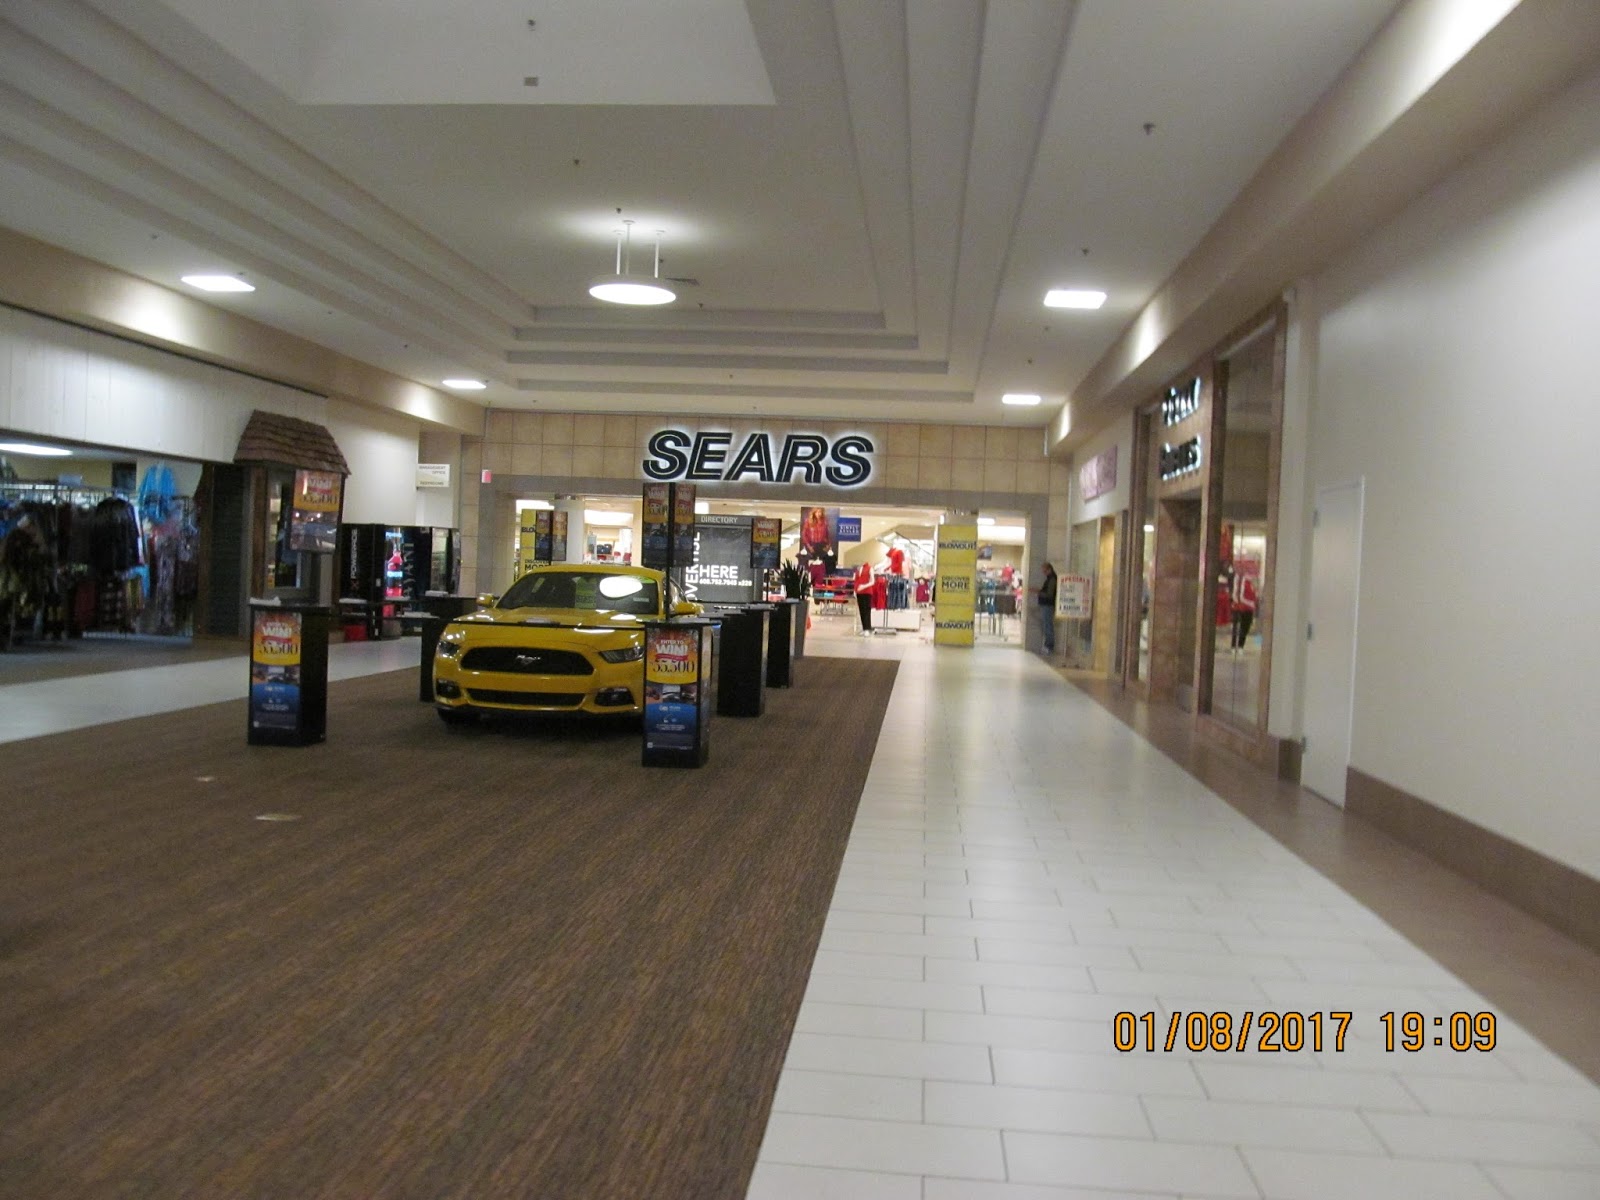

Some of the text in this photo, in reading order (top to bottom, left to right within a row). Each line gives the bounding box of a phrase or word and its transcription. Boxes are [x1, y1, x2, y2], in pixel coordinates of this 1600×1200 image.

[642, 429, 874, 487] SEARS
[701, 515, 739, 524] DIRECTORY
[699, 564, 738, 579] HERE
[942, 581, 970, 590] MORE
[655, 644, 689, 656] WIN!
